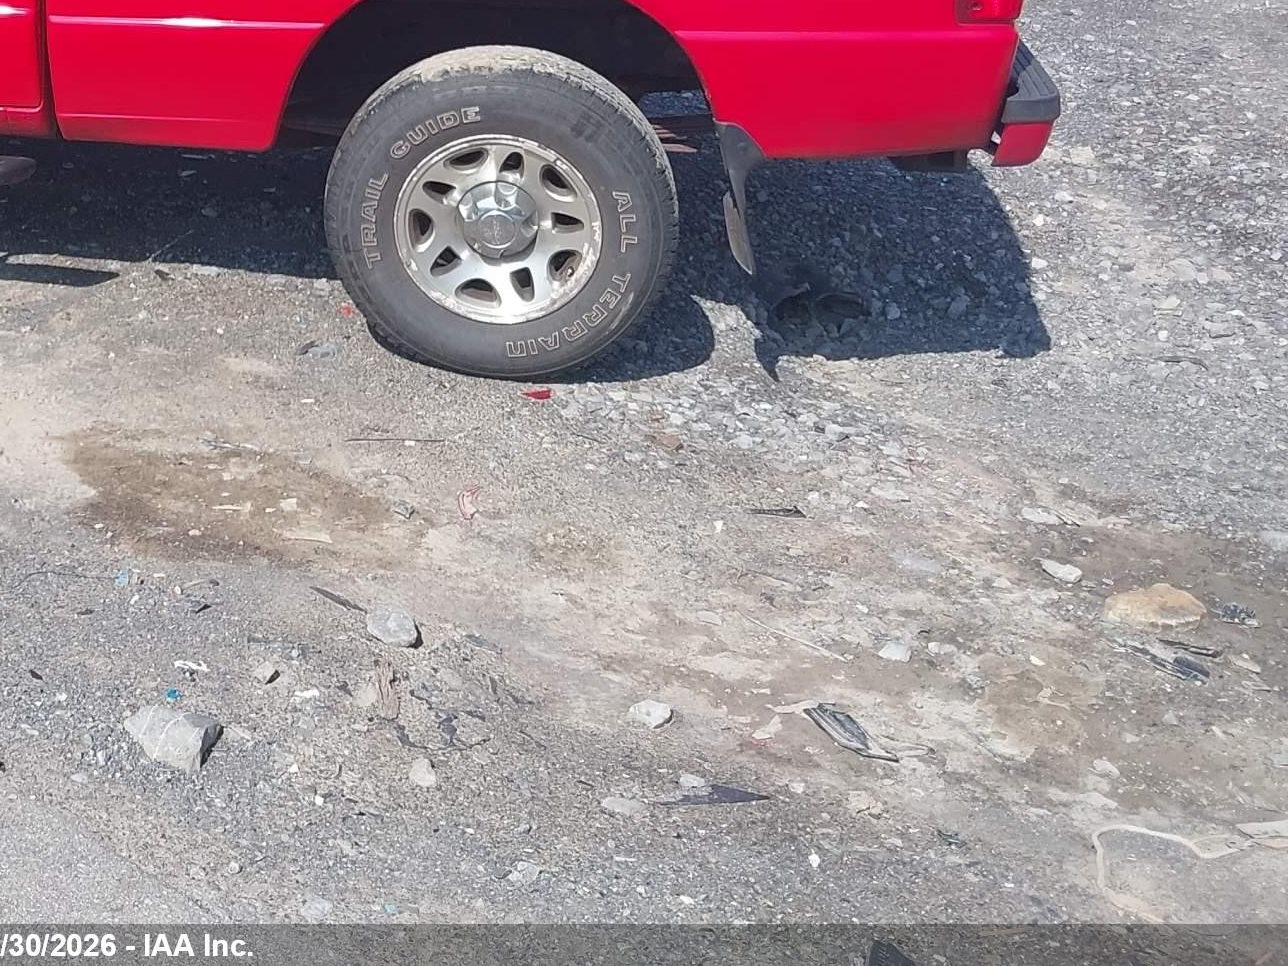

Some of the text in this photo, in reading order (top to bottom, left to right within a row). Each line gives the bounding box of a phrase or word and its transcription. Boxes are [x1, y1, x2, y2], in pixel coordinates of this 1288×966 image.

[358, 105, 481, 270] TRAIL GUIDE
[505, 189, 640, 358] ALL TERRAIN
